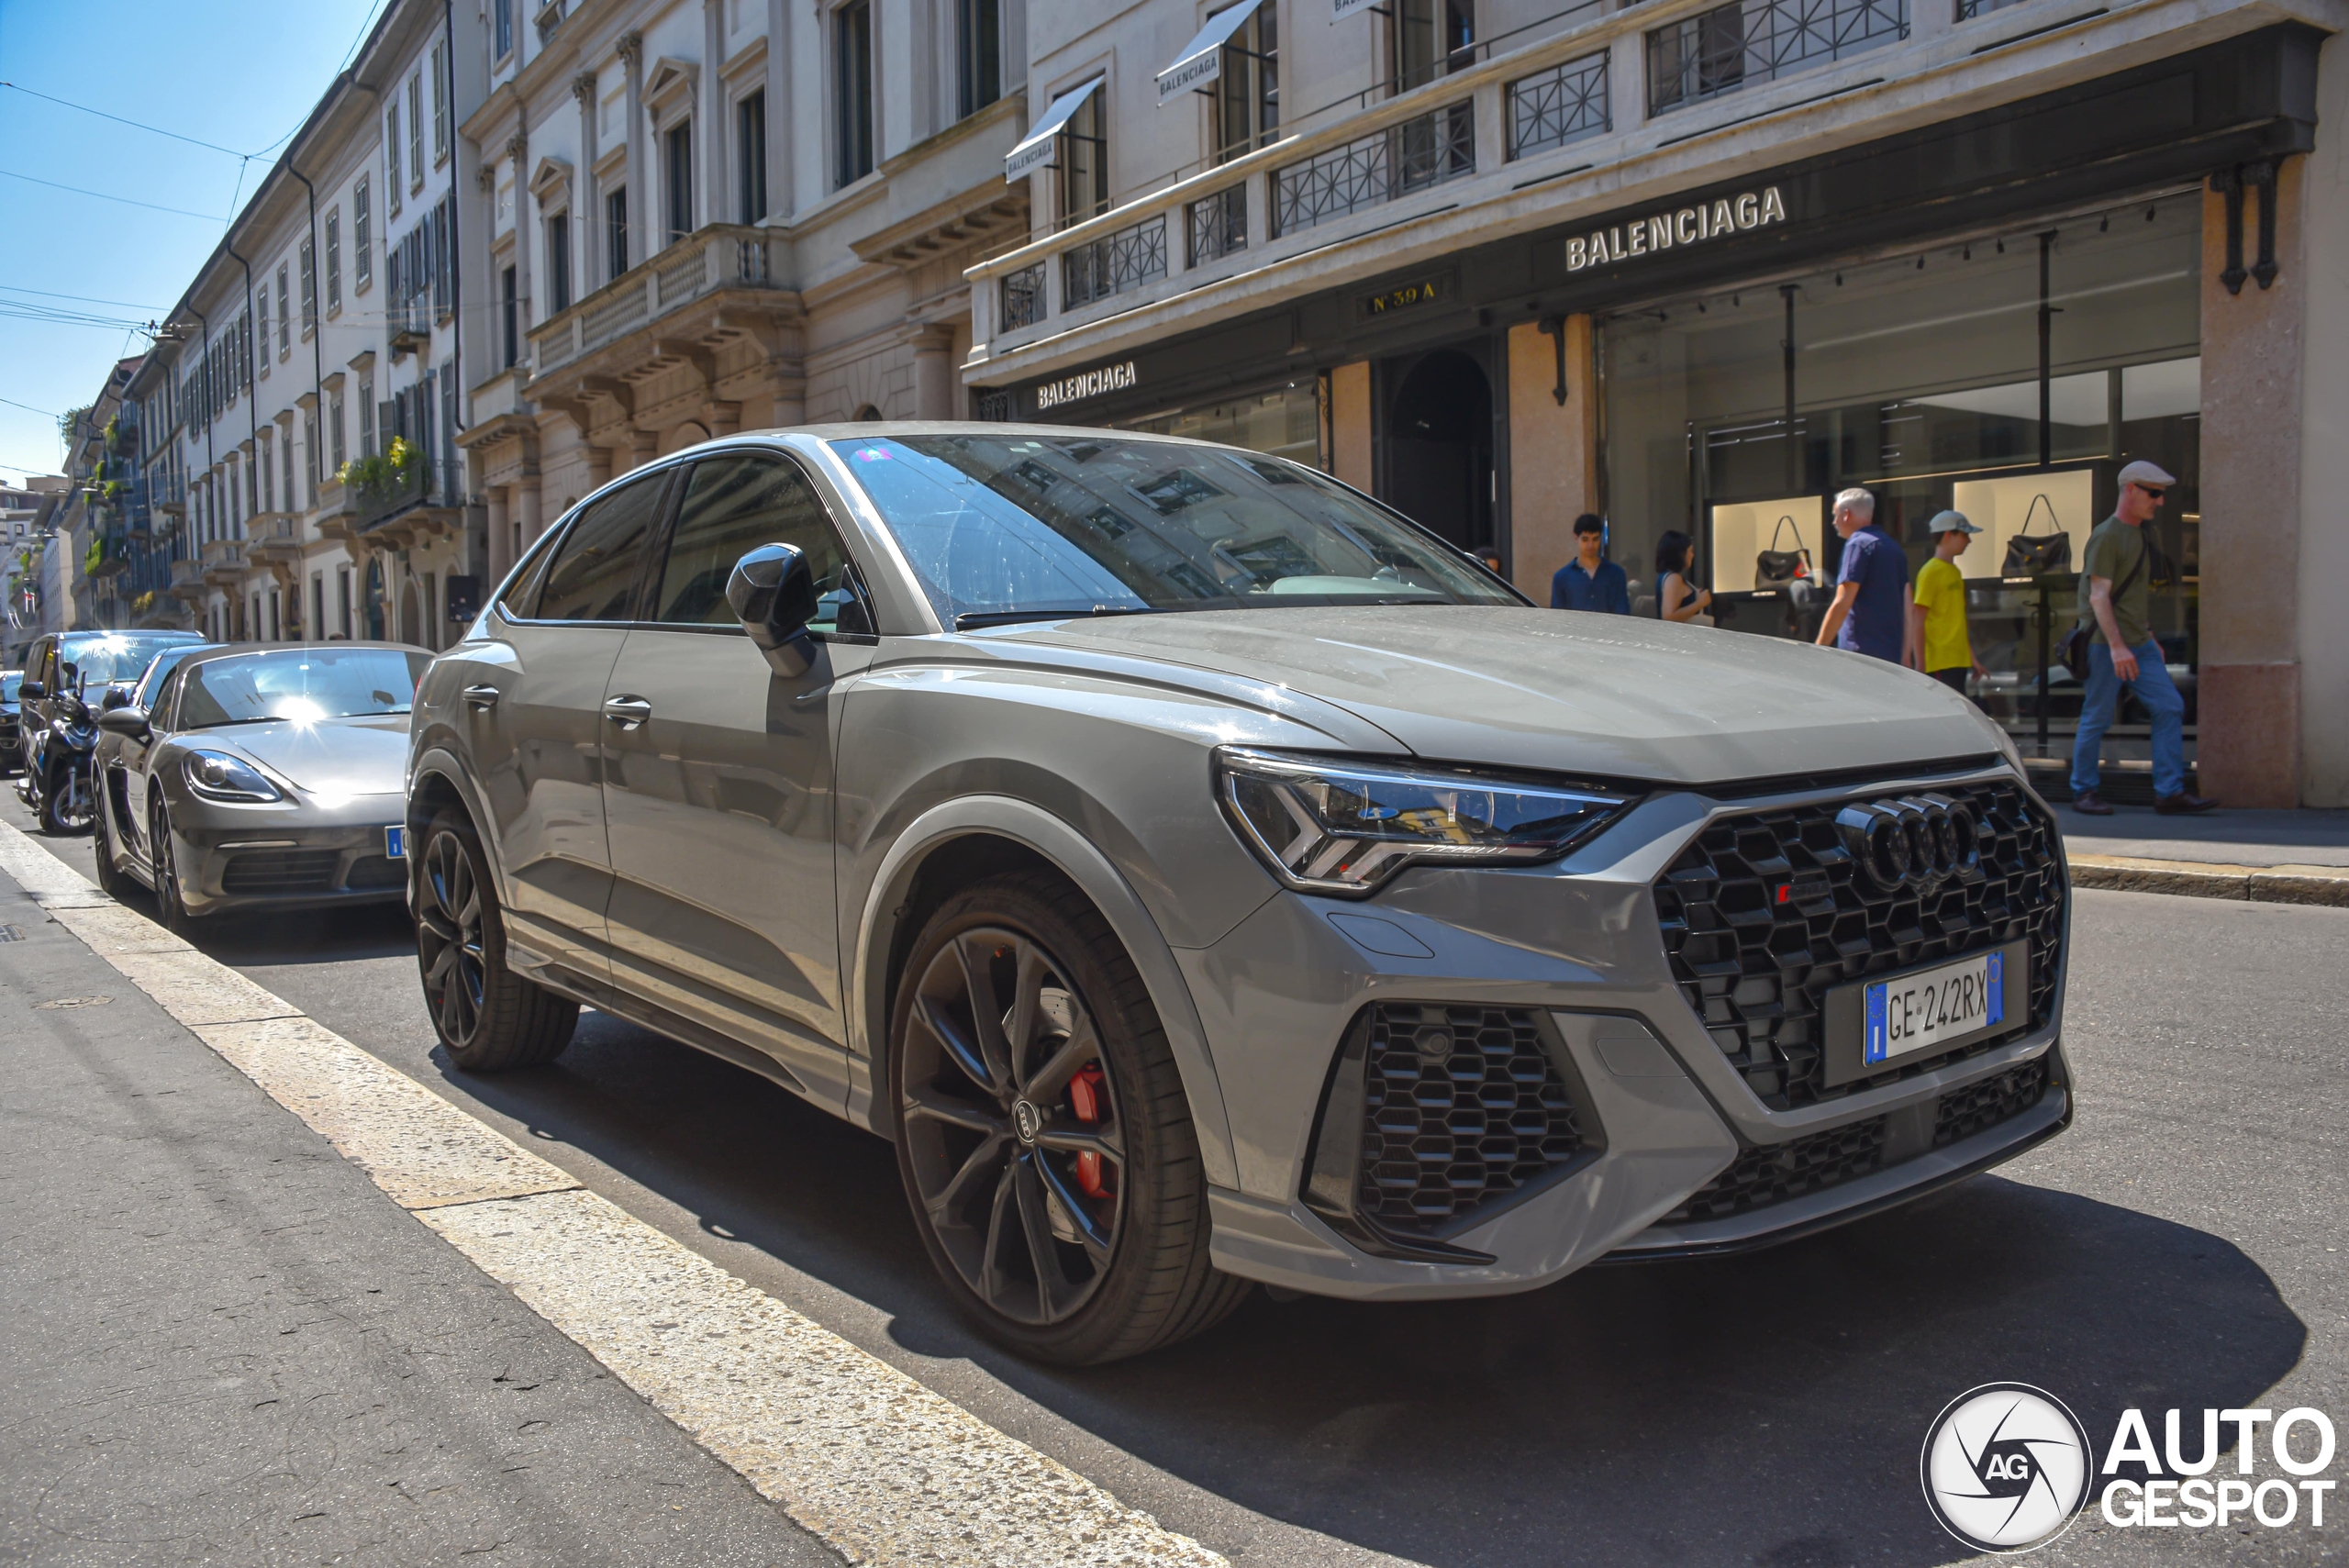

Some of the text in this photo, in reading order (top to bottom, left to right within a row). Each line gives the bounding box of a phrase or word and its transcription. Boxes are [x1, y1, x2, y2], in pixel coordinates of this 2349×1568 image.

[1160, 56, 1217, 96] BALENCIAGA
[1008, 142, 1052, 175] BALENCIAGA
[1566, 186, 1786, 272] BALENCIAGA
[1394, 287, 1418, 307] 39
[1422, 282, 1435, 300] A
[1038, 361, 1136, 409] BALENCIAGA
